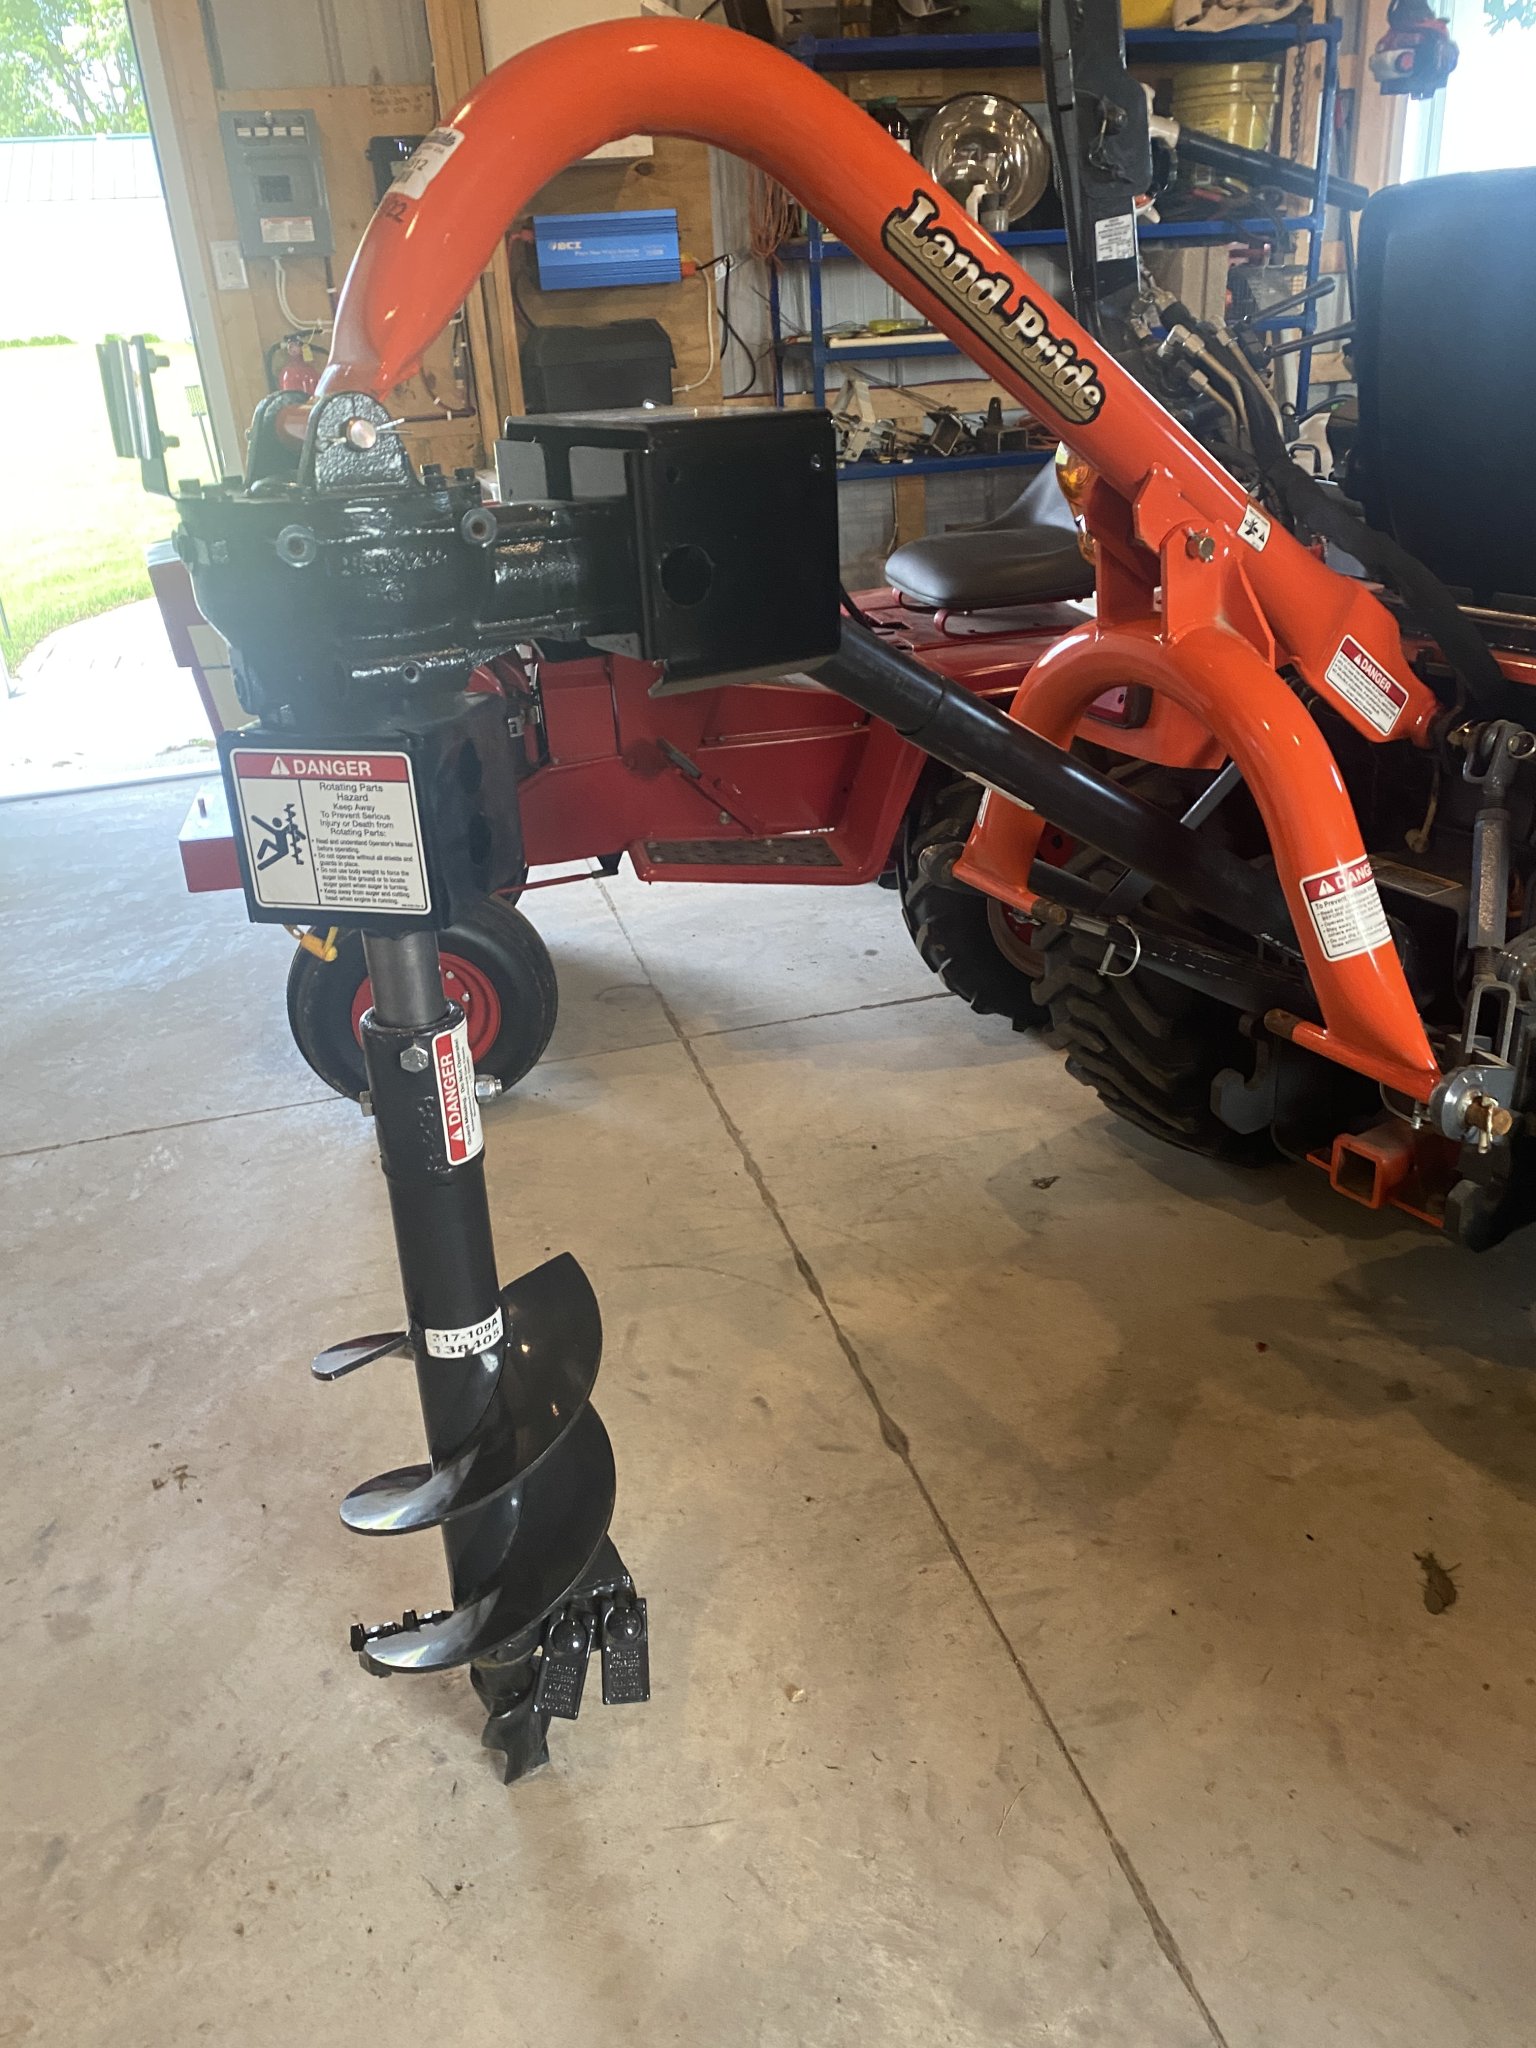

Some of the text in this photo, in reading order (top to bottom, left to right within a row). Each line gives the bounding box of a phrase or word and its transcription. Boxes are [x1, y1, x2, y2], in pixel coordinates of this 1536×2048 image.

[893, 193, 1102, 410] Land Pride
[1360, 659, 1392, 693] DANGER
[293, 759, 371, 776] DANGER
[320, 782, 383, 793] Rotating Parts
[336, 792, 369, 801] Hazard
[333, 803, 375, 813] Keep Away
[331, 811, 360, 819] Prevent
[362, 812, 391, 820] Serious
[320, 819, 340, 829] Injury
[352, 820, 374, 828] Death
[376, 821, 394, 829] from
[330, 828, 362, 837] Rotating
[1324, 896, 1346, 907] Prevent
[440, 1052, 461, 1127] DANGER
